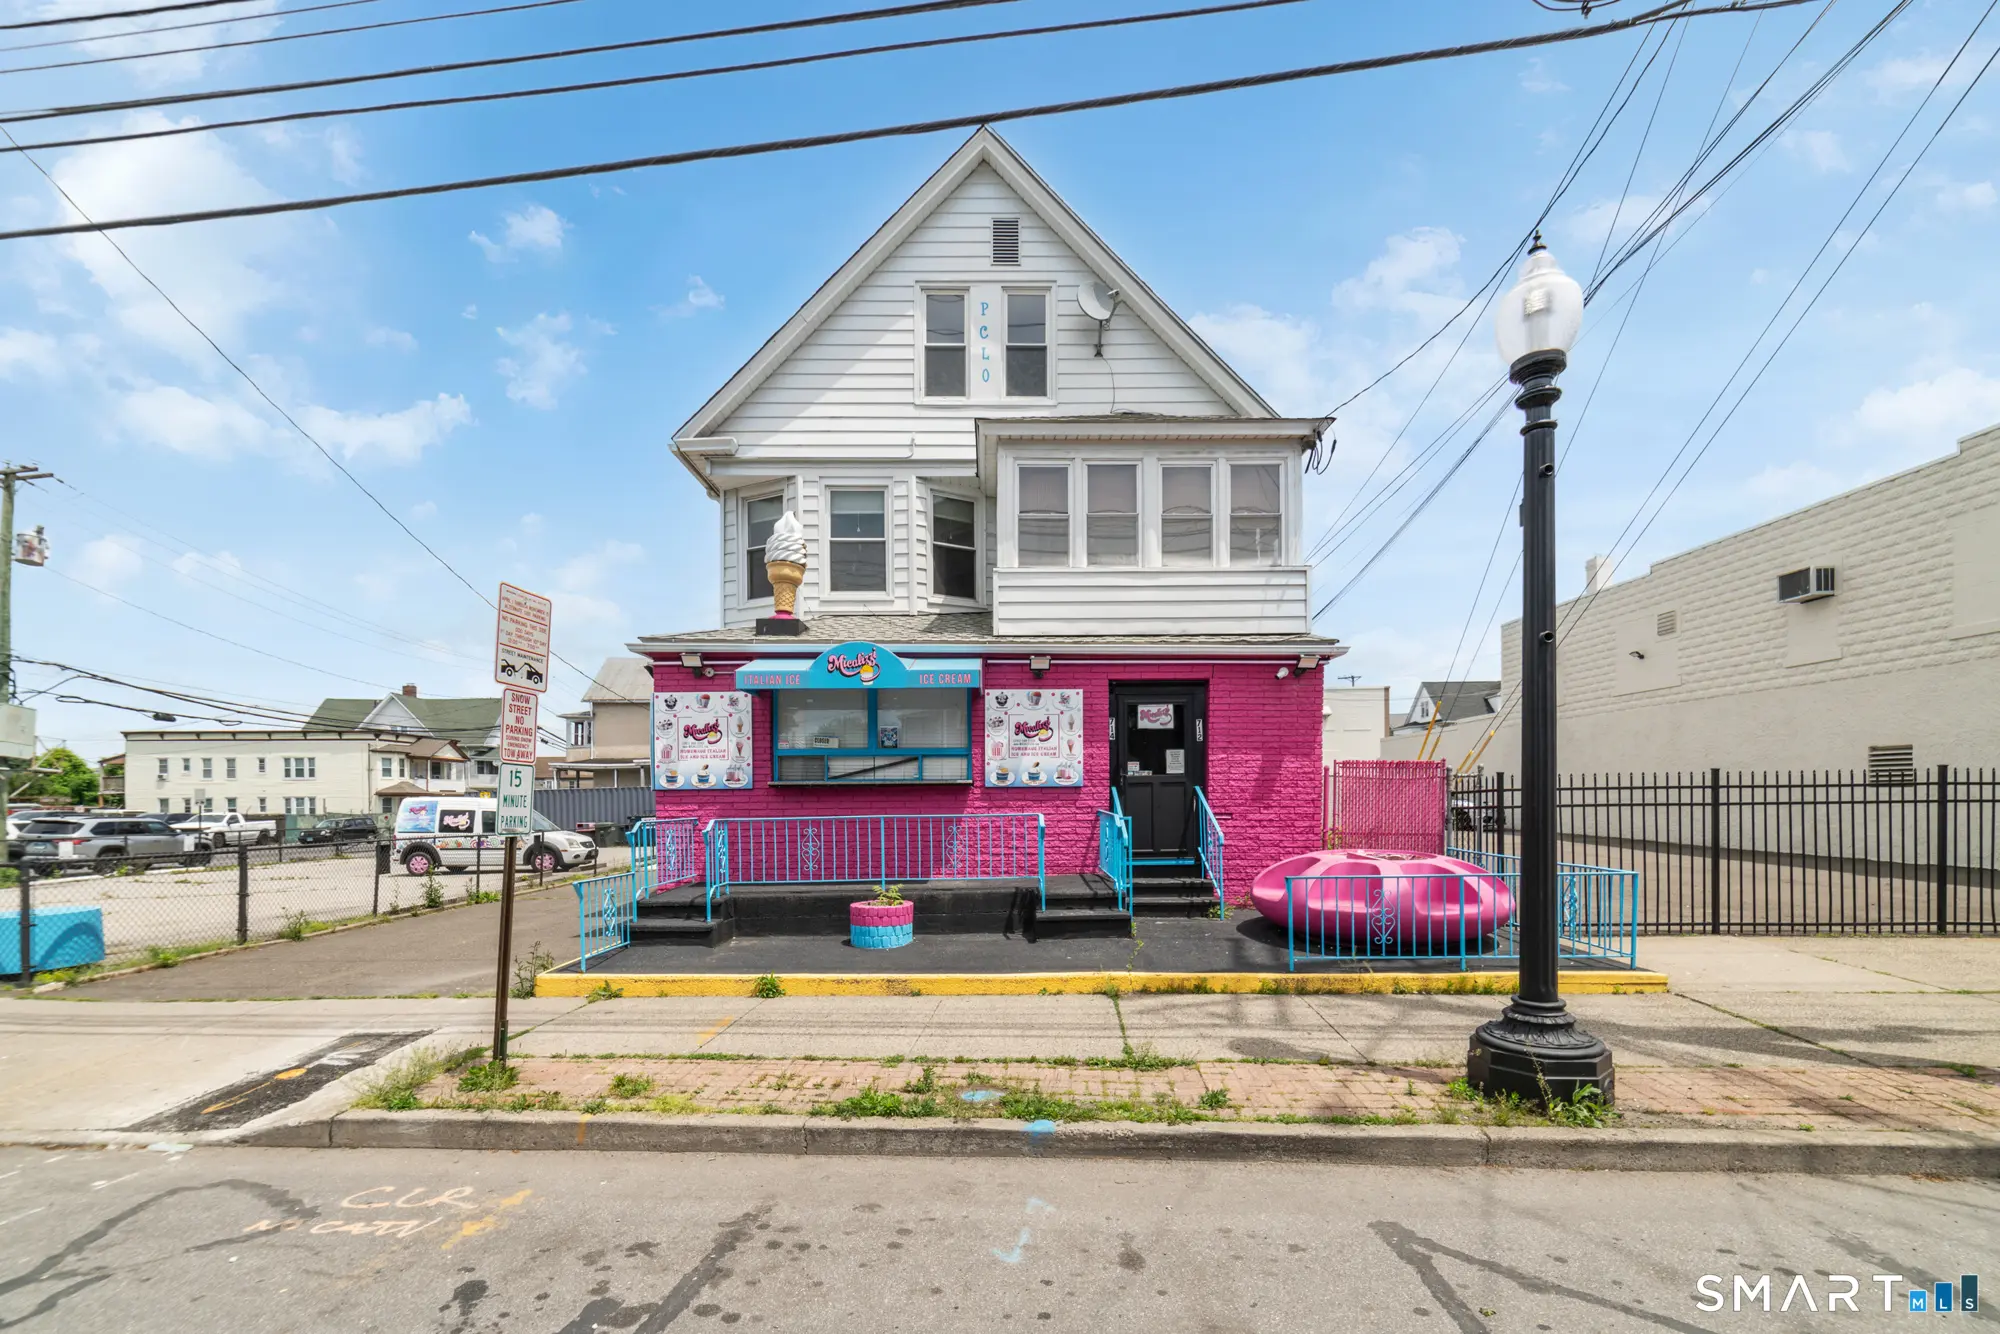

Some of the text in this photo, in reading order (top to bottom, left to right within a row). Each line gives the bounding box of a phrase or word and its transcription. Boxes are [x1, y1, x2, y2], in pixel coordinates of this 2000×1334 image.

[502, 648, 544, 664] STREET MAINTENANCE
[744, 674, 800, 684] ITALIAN ICE
[919, 674, 971, 684] ICE CREAM
[511, 693, 530, 704] SNOW
[509, 704, 532, 716] STREET
[515, 716, 524, 725] NO
[506, 725, 532, 736] PARKING
[504, 748, 533, 760] TOW AWAY
[510, 770, 522, 788] 15
[503, 794, 527, 808] MINUTE
[501, 816, 527, 828] PARKING
